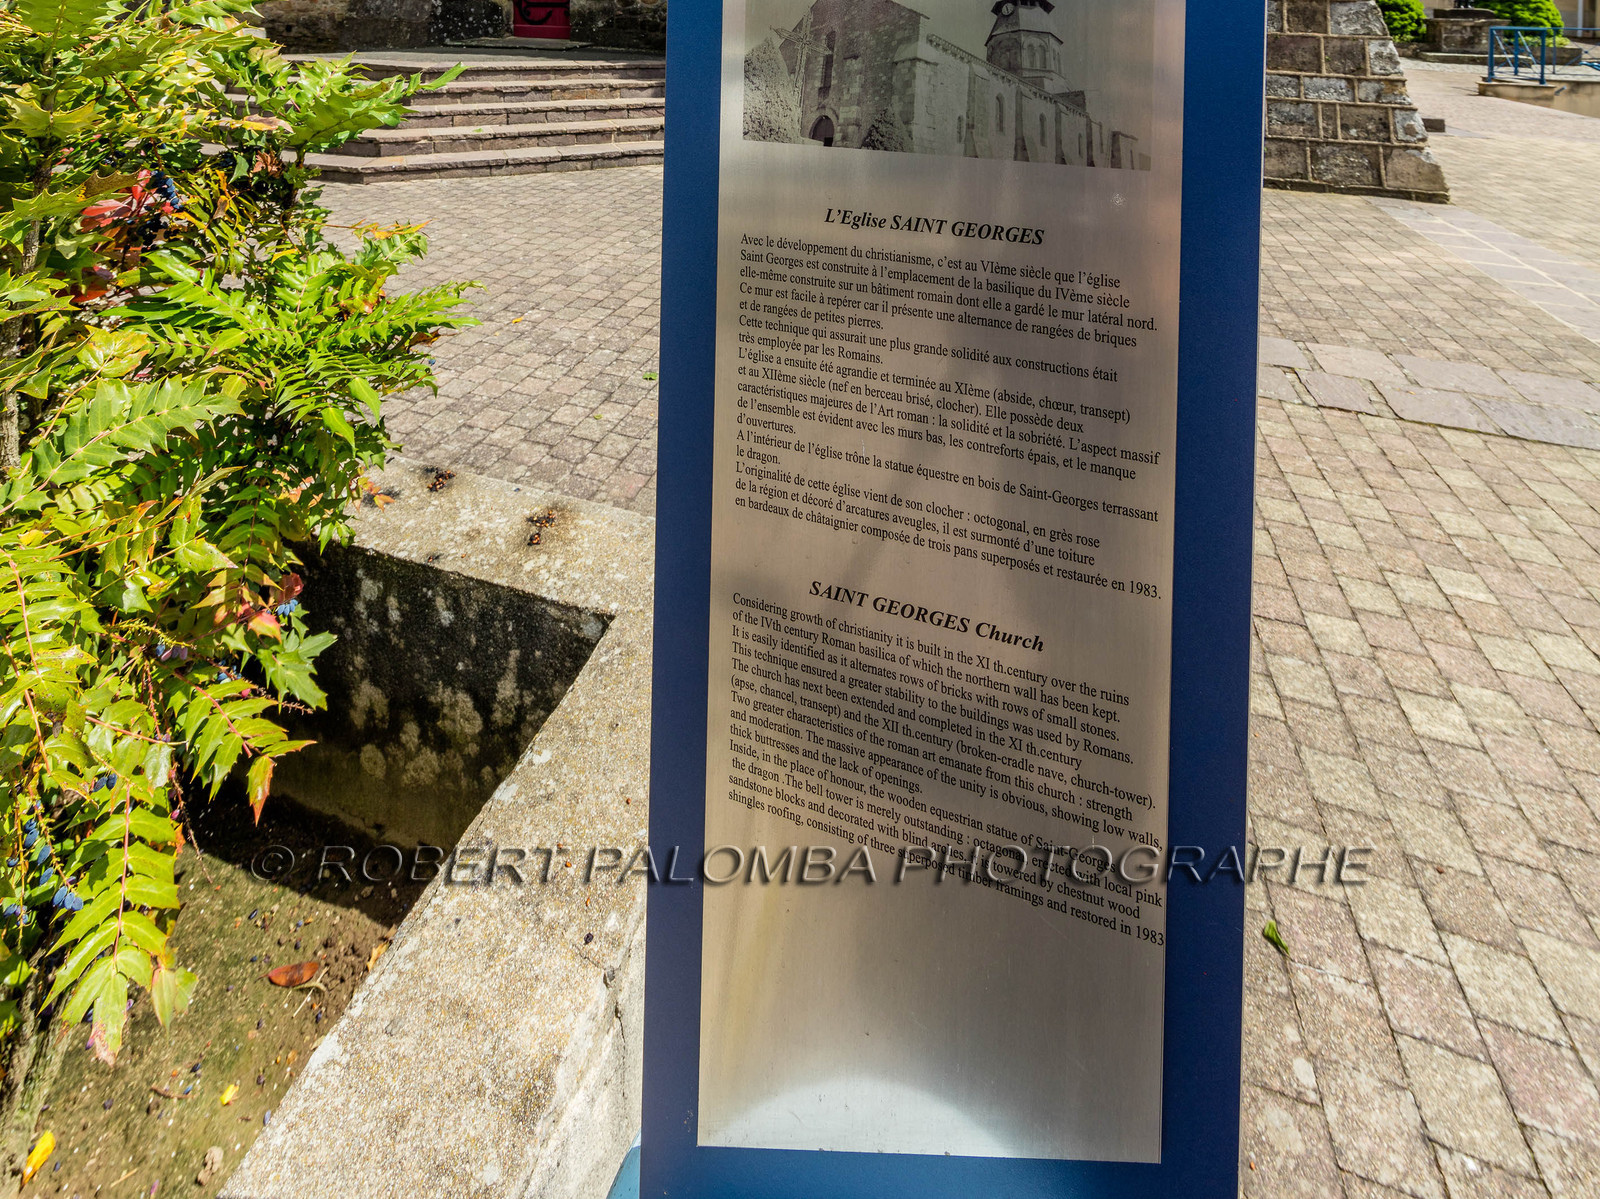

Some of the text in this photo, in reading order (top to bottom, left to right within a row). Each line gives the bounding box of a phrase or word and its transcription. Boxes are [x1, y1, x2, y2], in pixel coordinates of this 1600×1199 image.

[740, 231, 764, 247] Avec
[765, 234, 775, 248] le
[776, 235, 848, 257] développement
[849, 244, 863, 259] du
[864, 246, 934, 269] christianisme,
[964, 261, 978, 272] au
[980, 259, 1017, 277] VIème
[1019, 264, 1051, 281] siècle
[1053, 271, 1075, 285] que
[890, 214, 947, 235] SAINT
[951, 221, 1045, 245] GEORGES
[739, 264, 1157, 331] elle-même construite sur un bâtiment romain dont elle a gardé le mur latéral nord.
[739, 298, 883, 330] et de rangées de petites pierres.
[738, 330, 883, 365] très employée par les Romains.
[736, 427, 745, 441] A
[793, 438, 805, 453] de
[844, 449, 870, 466] trône
[872, 454, 882, 468] la
[884, 459, 914, 474] statue
[916, 462, 959, 483] équestre
[961, 475, 975, 487] en
[977, 474, 1000, 492] bois
[1002, 479, 1016, 495] de
[1018, 482, 1099, 512] Saint-Georges
[1101, 500, 1158, 522] terrassant
[734, 495, 1161, 598] en bardeaux de châtaignier composée de trois pans superposés et restaurée en 1983.
[732, 591, 1129, 706] Considering growth of christianity it is built in the XI th.century over the ruins
[809, 581, 1044, 652] SAINT GEORGES Church
[731, 656, 1082, 771] The church has next been extended and completed in the XI th.century
[732, 623, 1119, 741] It is easily identified as it alternates rows of bricks with rows of small stones.
[729, 722, 923, 795] thick buttresses and the lack of openings.
[730, 672, 1155, 811] (apse, chancel, transept) and the XII th.century (broken-cradle nave, church-tower).
[730, 708, 1163, 853] and moderation. The massive appearance of the unity is obvious, showing low walls,
